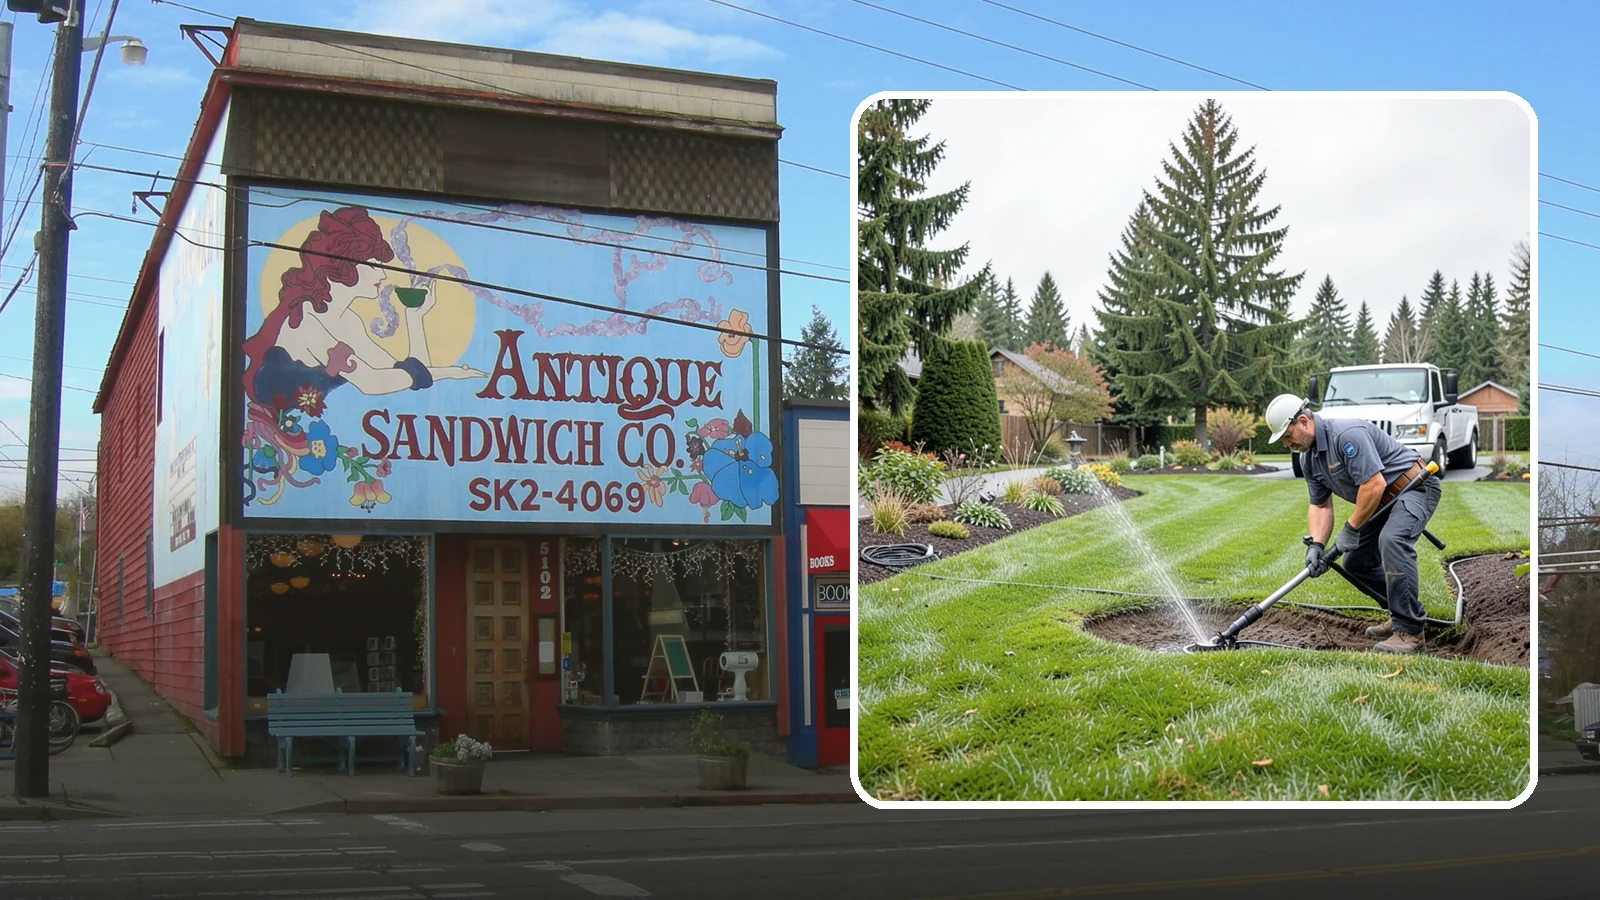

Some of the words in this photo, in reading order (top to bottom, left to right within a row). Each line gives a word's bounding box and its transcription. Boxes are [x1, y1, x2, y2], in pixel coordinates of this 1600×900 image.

[476, 330, 723, 419] ANTIQUE
[361, 409, 604, 467] SANDWICH
[617, 422, 684, 469] CO.
[468, 477, 645, 513] SK2-4069
[539, 541, 552, 600] 5102
[809, 555, 835, 569] BOOKS
